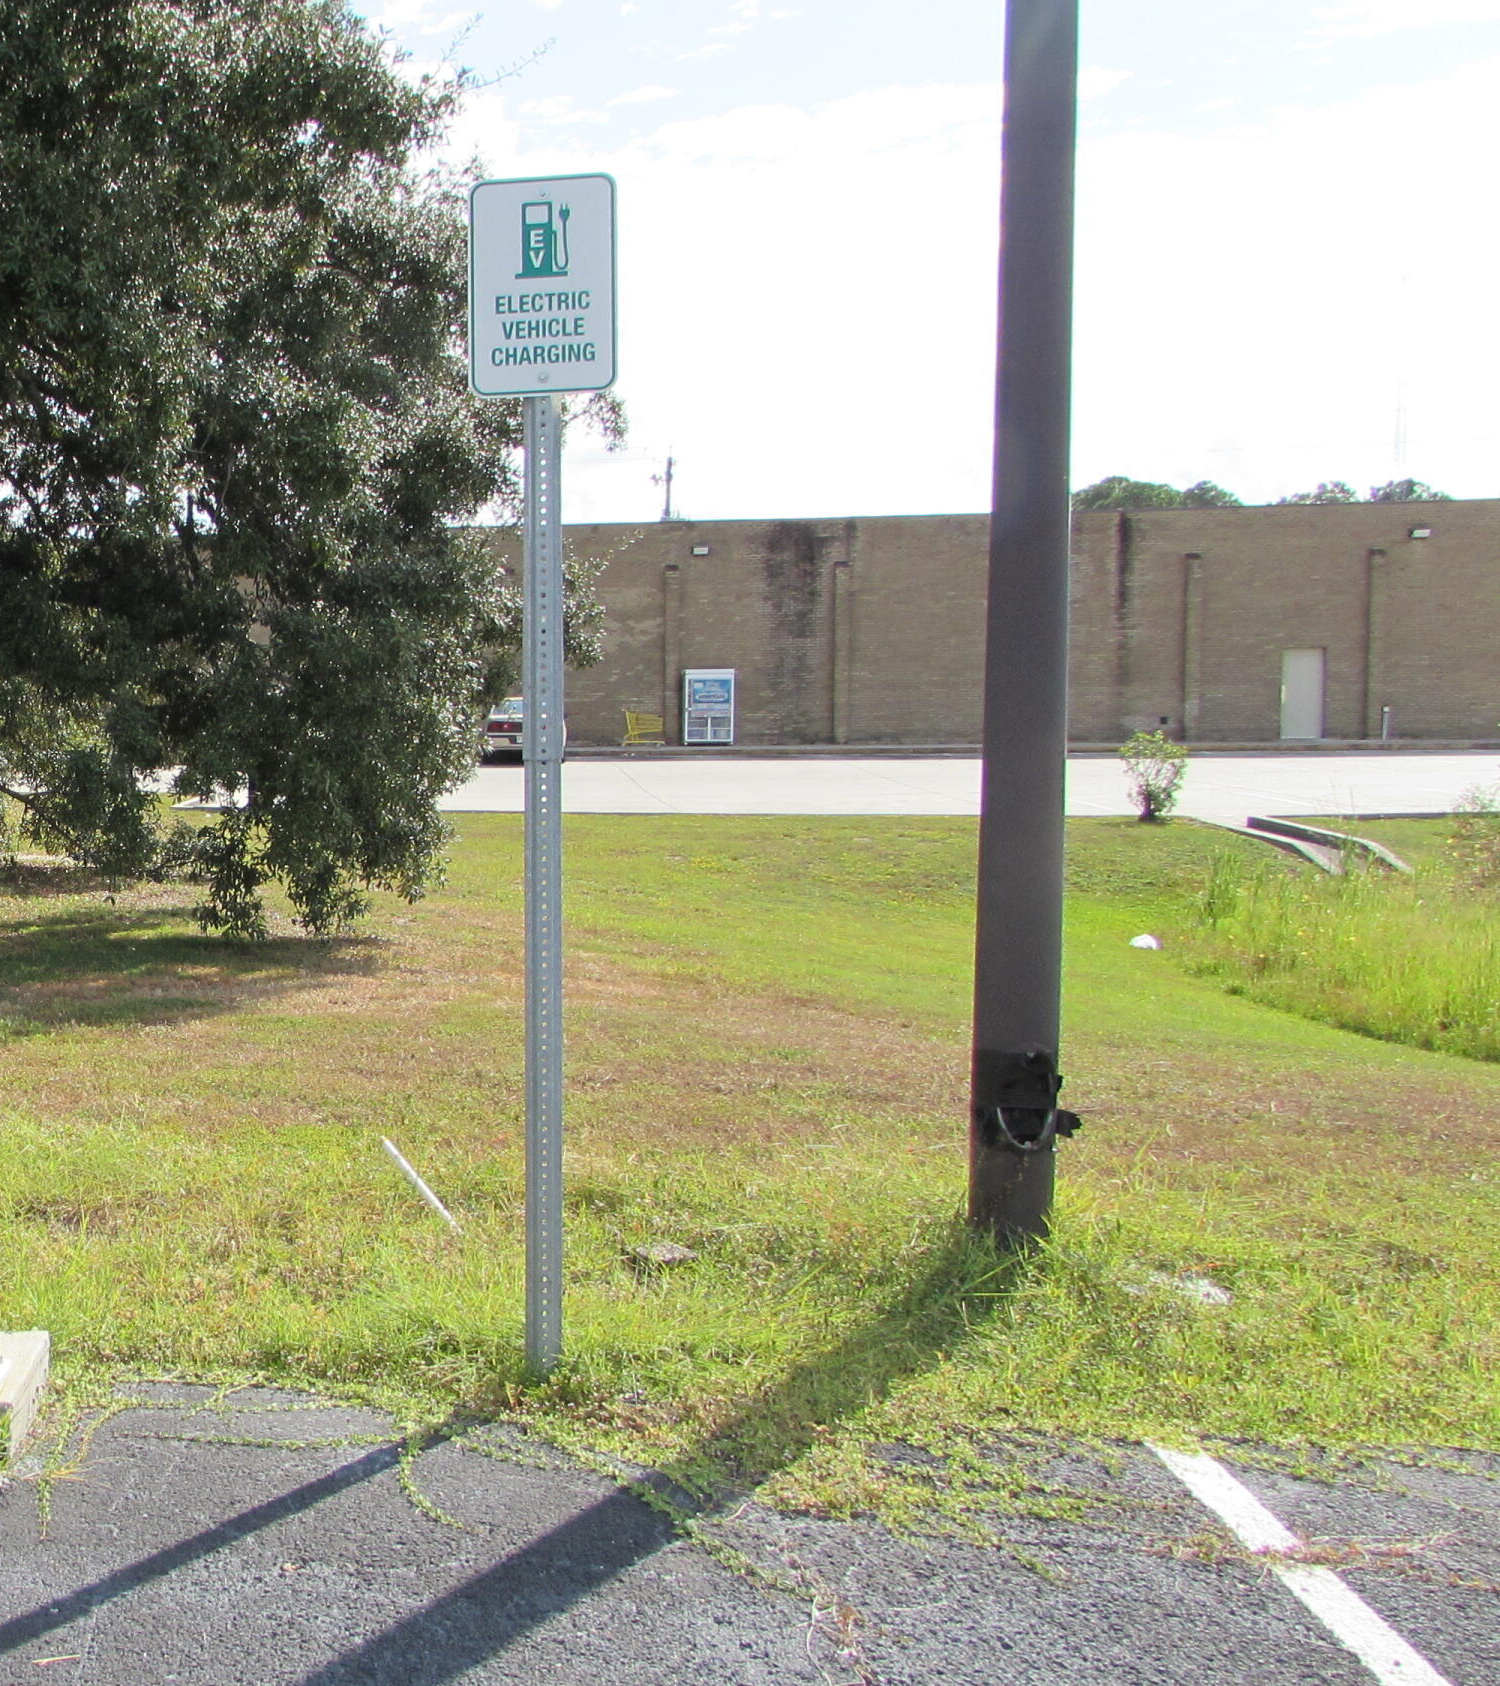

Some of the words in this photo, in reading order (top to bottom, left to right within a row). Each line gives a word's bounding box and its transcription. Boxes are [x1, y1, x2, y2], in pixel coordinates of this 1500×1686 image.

[495, 290, 590, 315] ELECTRIC
[502, 317, 585, 340] VEHICLE
[491, 342, 596, 367] CHARGING
